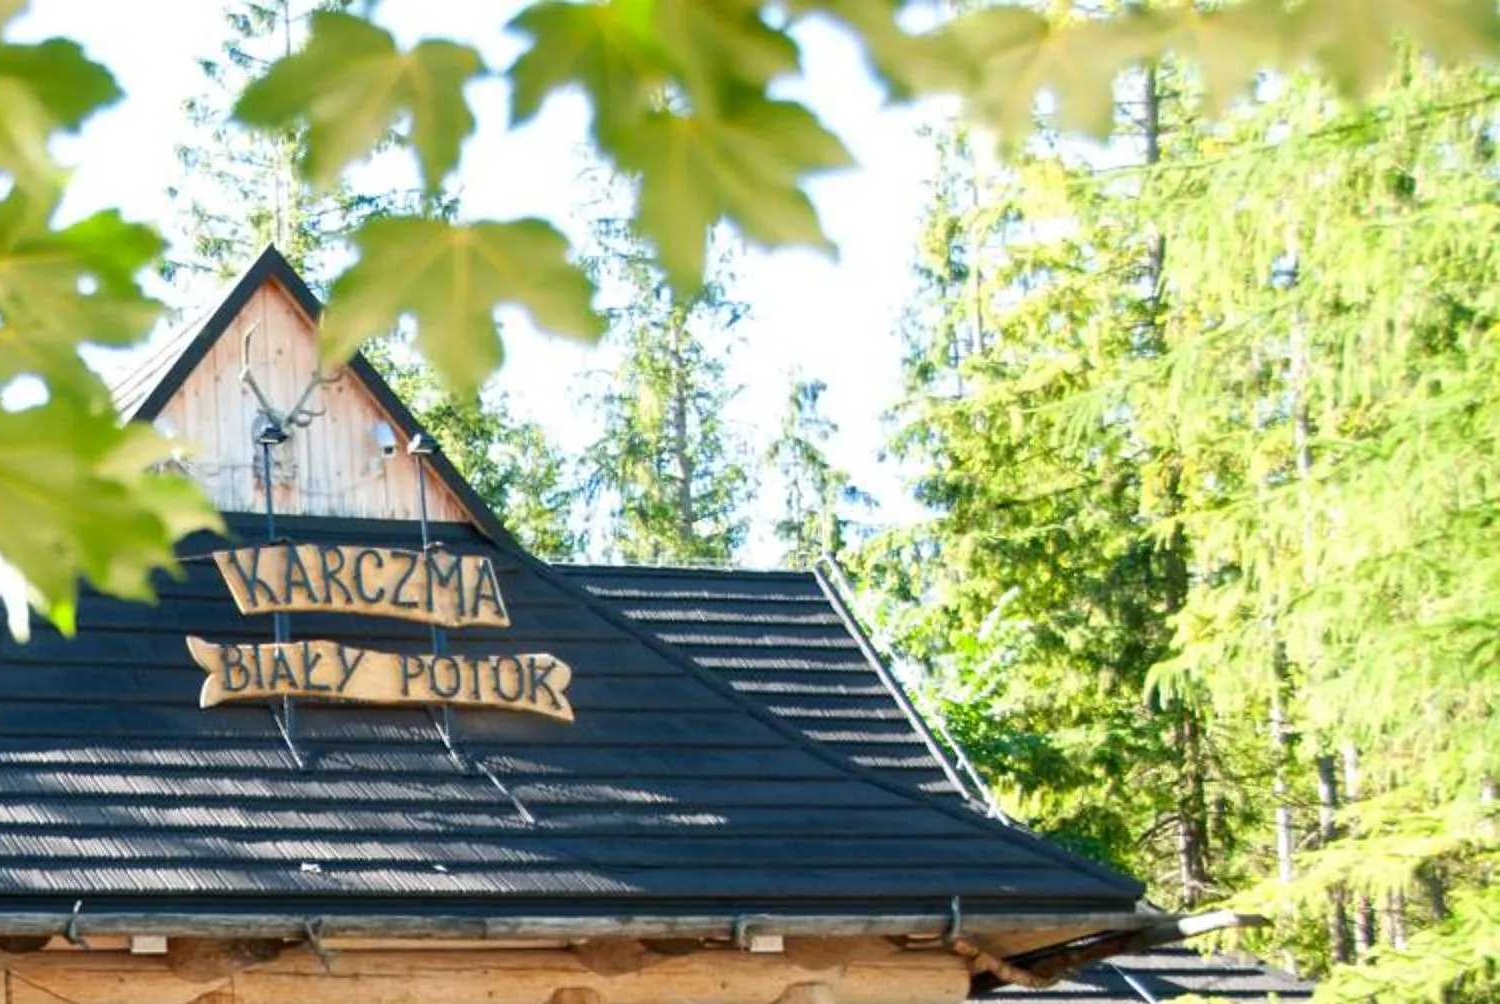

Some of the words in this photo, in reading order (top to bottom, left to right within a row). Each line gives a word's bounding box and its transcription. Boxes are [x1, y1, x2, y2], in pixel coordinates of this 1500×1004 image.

[228, 546, 505, 618] KARCZMA
[220, 641, 366, 693] BIAŁY
[400, 654, 564, 709] POTOK
